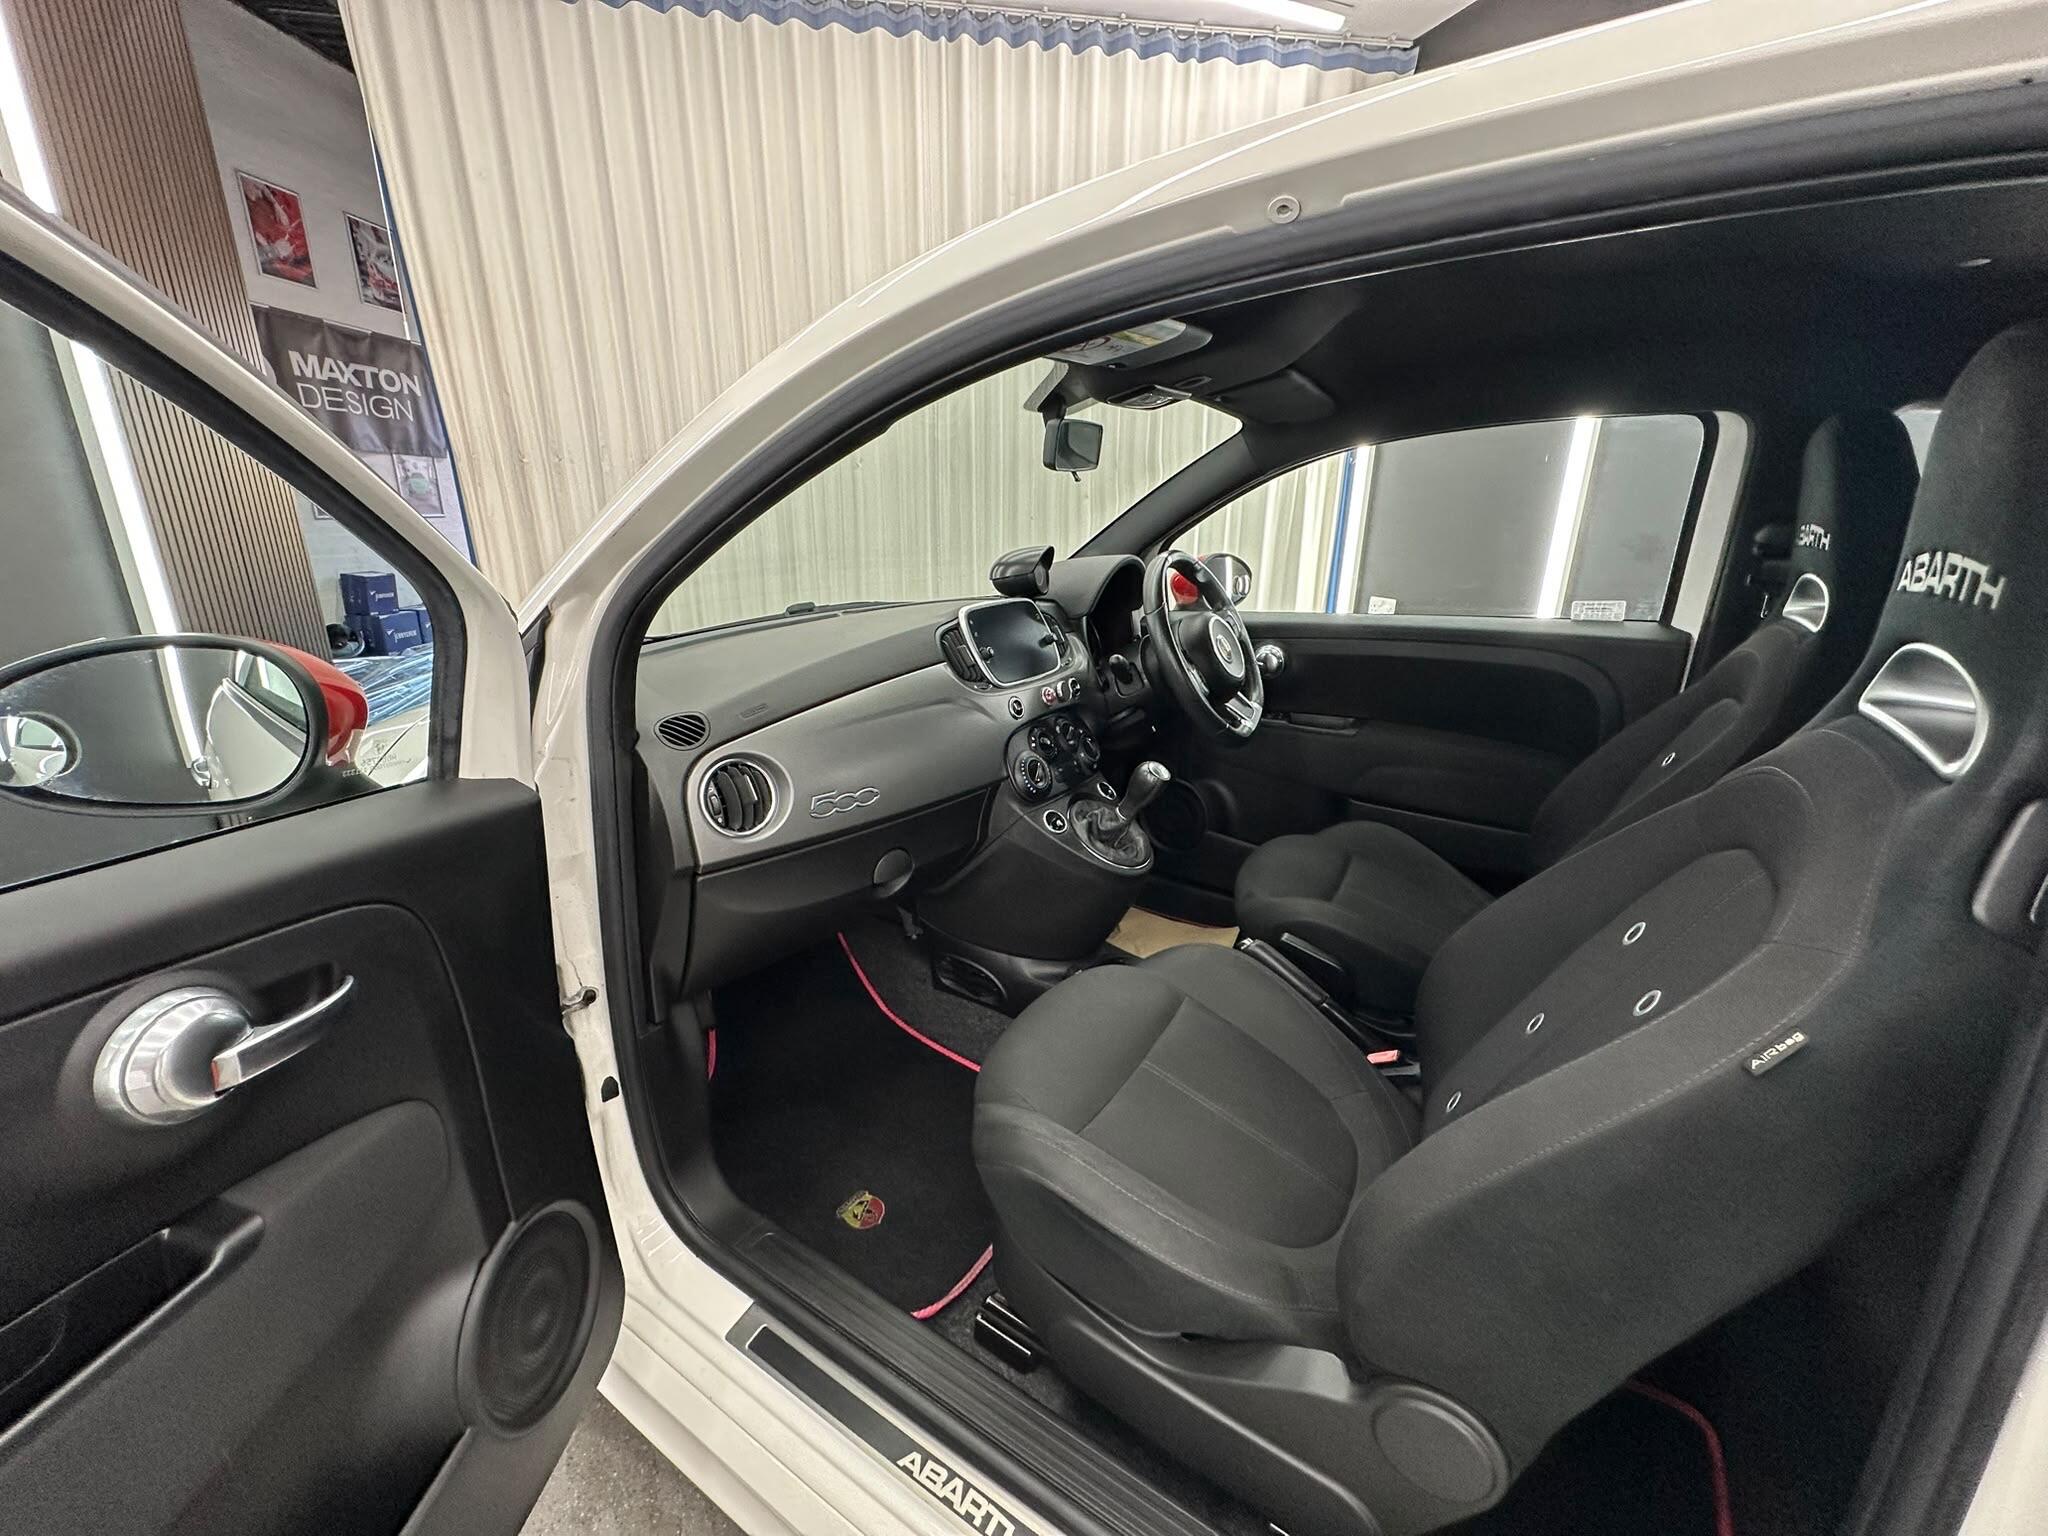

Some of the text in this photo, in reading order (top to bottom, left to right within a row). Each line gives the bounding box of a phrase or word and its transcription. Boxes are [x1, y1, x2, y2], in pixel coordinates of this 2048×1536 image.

[288, 350, 421, 396] MAXTON
[296, 382, 413, 421] DESIGN
[1797, 523, 1831, 551] BARTH
[1897, 551, 2006, 609] ABARTH
[809, 787, 880, 818] 500
[896, 1451, 1016, 1536] ABART
